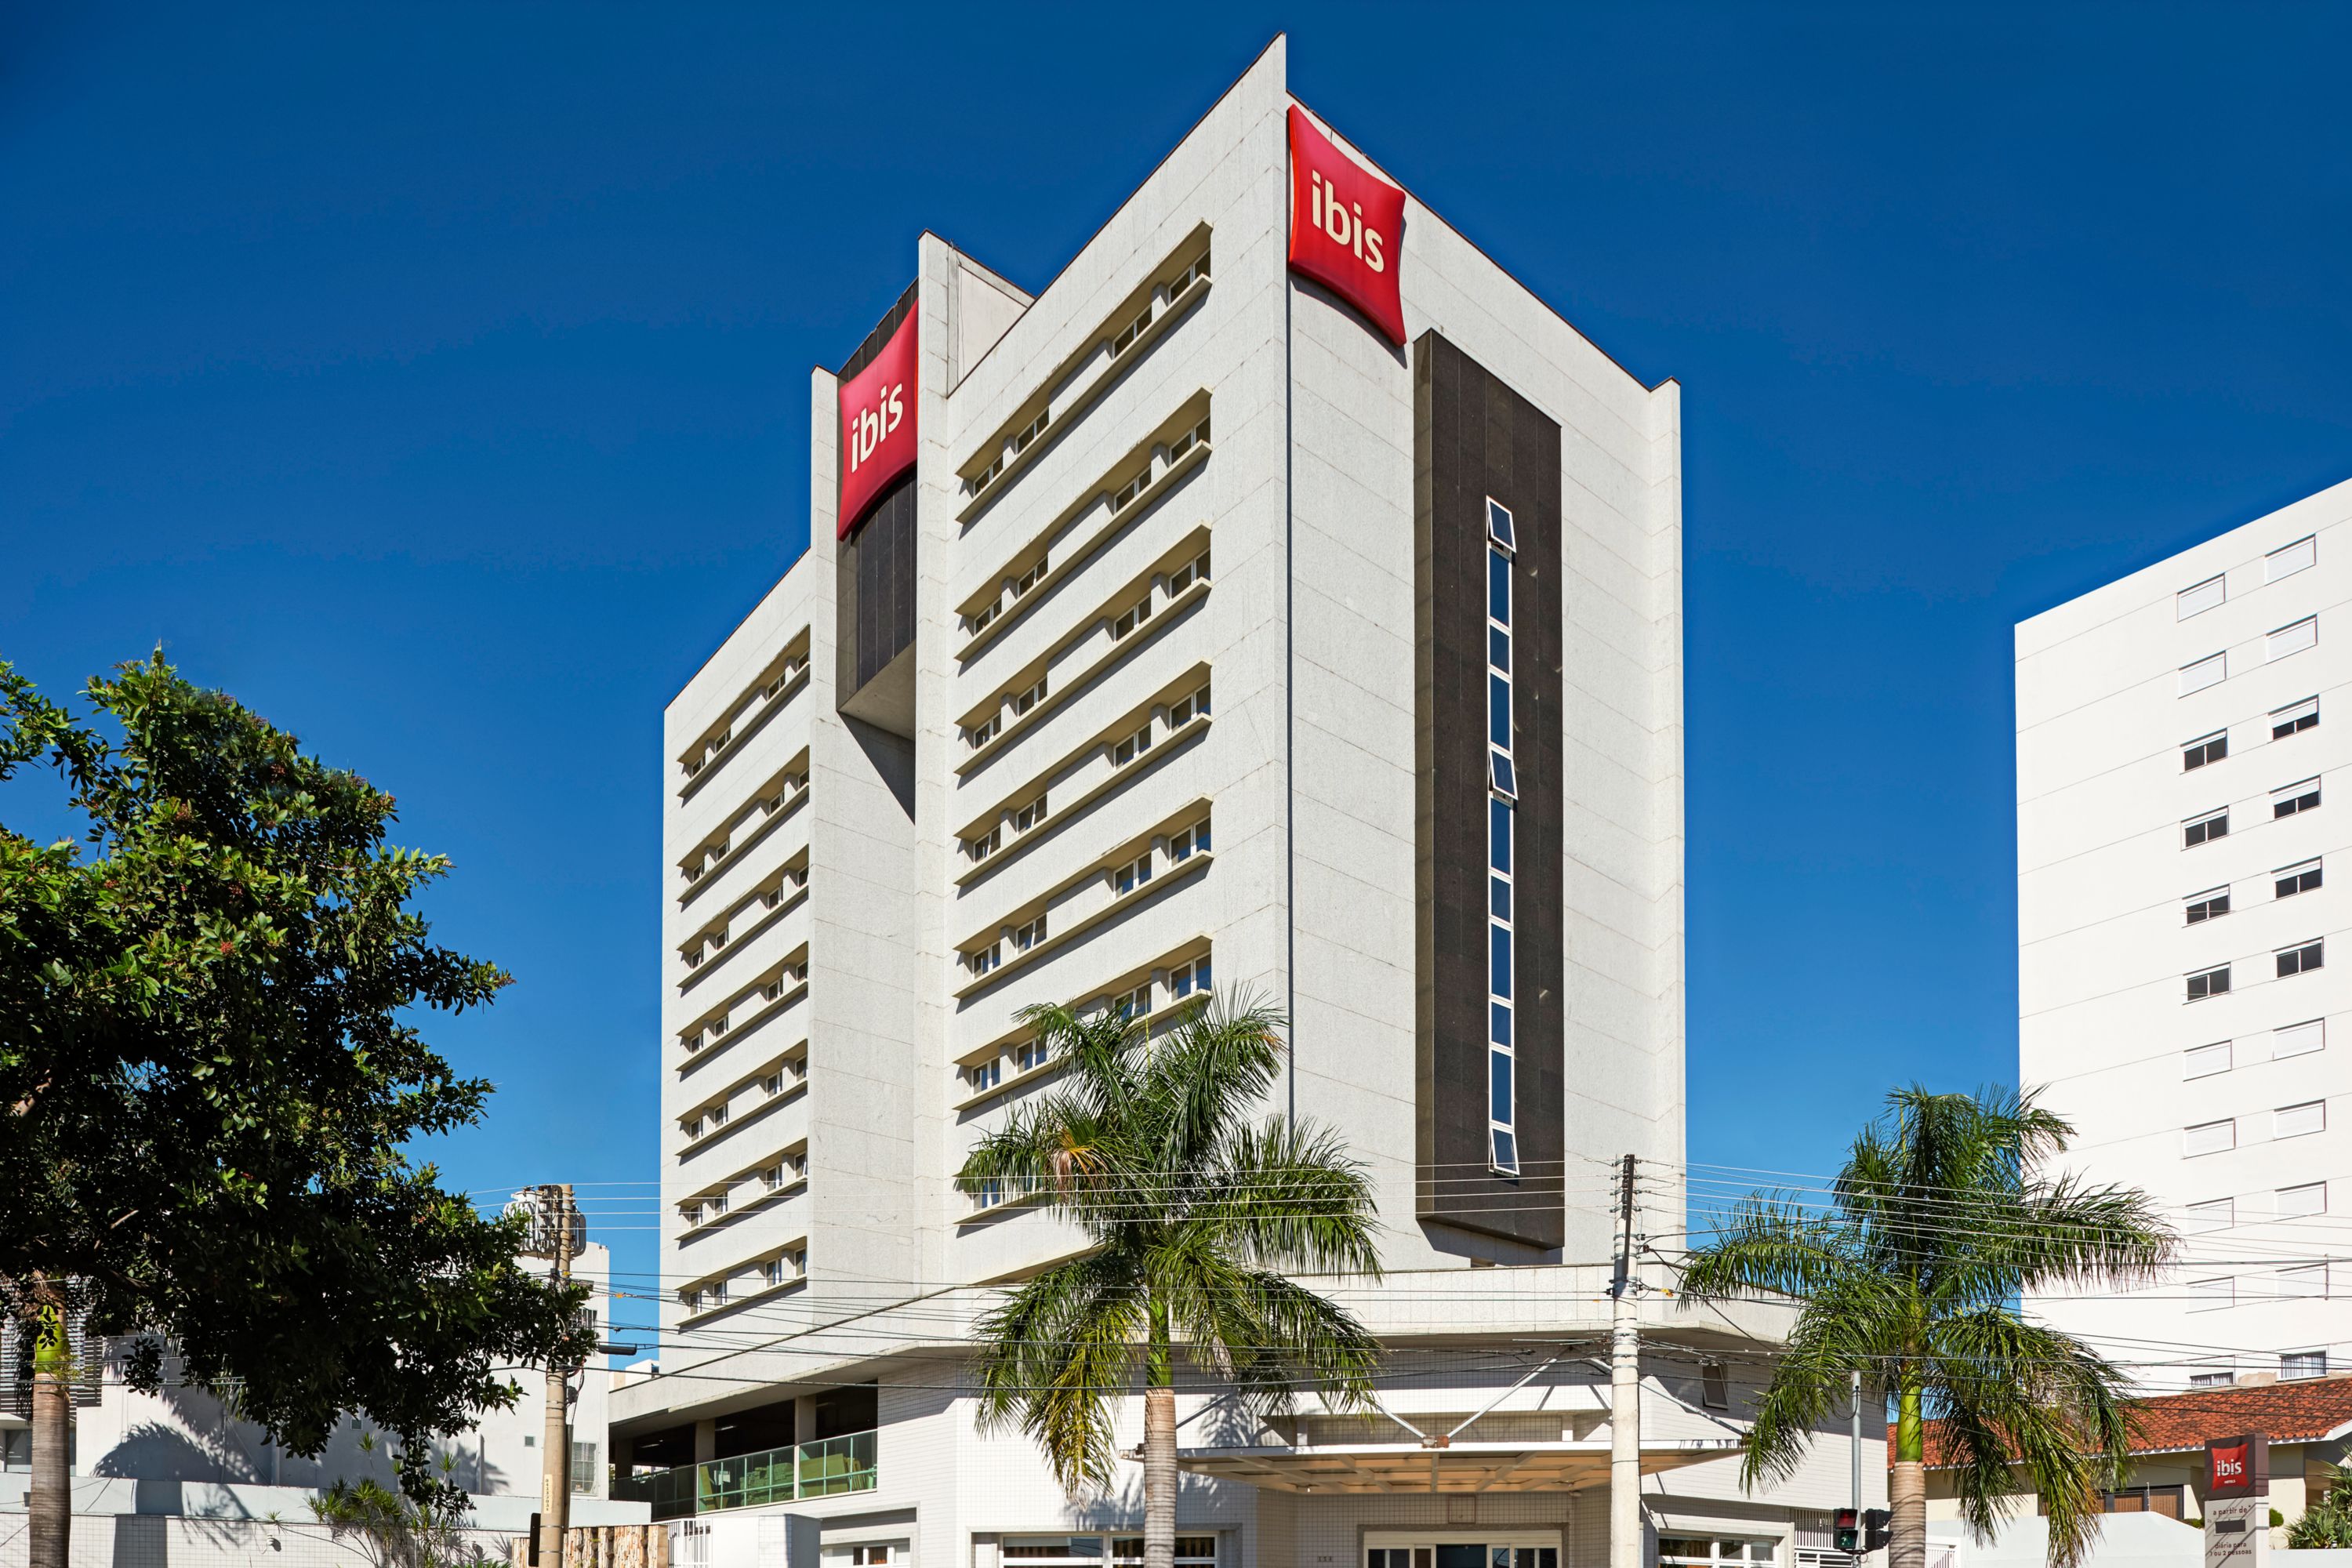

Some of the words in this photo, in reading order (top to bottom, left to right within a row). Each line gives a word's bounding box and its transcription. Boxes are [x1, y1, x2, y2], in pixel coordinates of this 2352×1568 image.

[1312, 169, 1385, 273] ibis
[851, 383, 903, 474] ibis
[2217, 1459, 2242, 1477] ibis
[2218, 1507, 2238, 1517] partir
[2227, 1549, 2252, 1558] pessoas
